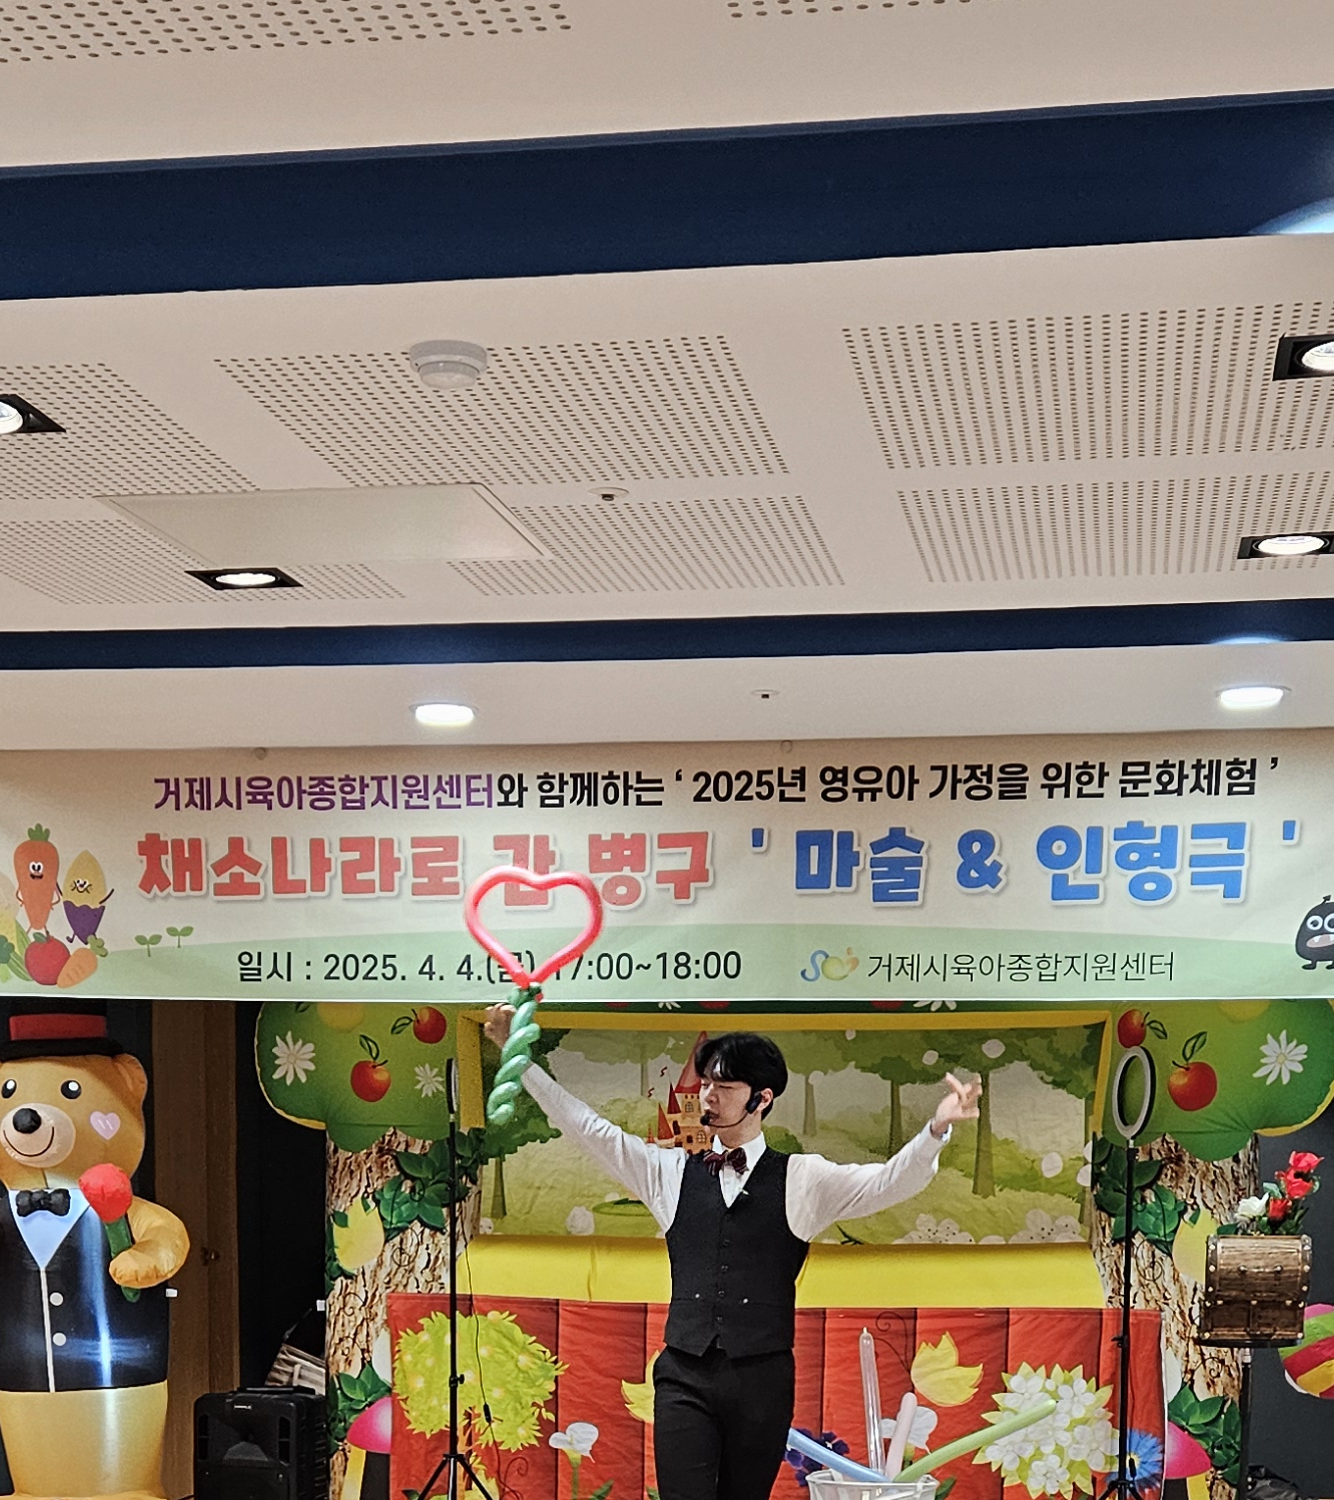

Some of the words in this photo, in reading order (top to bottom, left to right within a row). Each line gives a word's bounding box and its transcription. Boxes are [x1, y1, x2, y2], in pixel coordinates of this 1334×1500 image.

[153, 772, 528, 812] 거제시육아종합지원센터와
[536, 770, 665, 808] 함께하는
[819, 764, 920, 803] 영유아
[929, 762, 1029, 801] 가정을
[1040, 761, 1110, 799] 위한
[1118, 757, 1258, 798] 문화체험
[137, 831, 461, 898] 채소나라로
[492, 833, 557, 906] 간
[588, 831, 710, 907] 병구
[795, 826, 925, 903] 마술
[956, 829, 1004, 889] &
[1036, 820, 1248, 902] 인형극
[237, 951, 292, 983] 일시
[323, 953, 408, 981] 2025.
[418, 953, 445, 981] 4.
[867, 951, 1176, 983] 거제시육아종합지원센터
